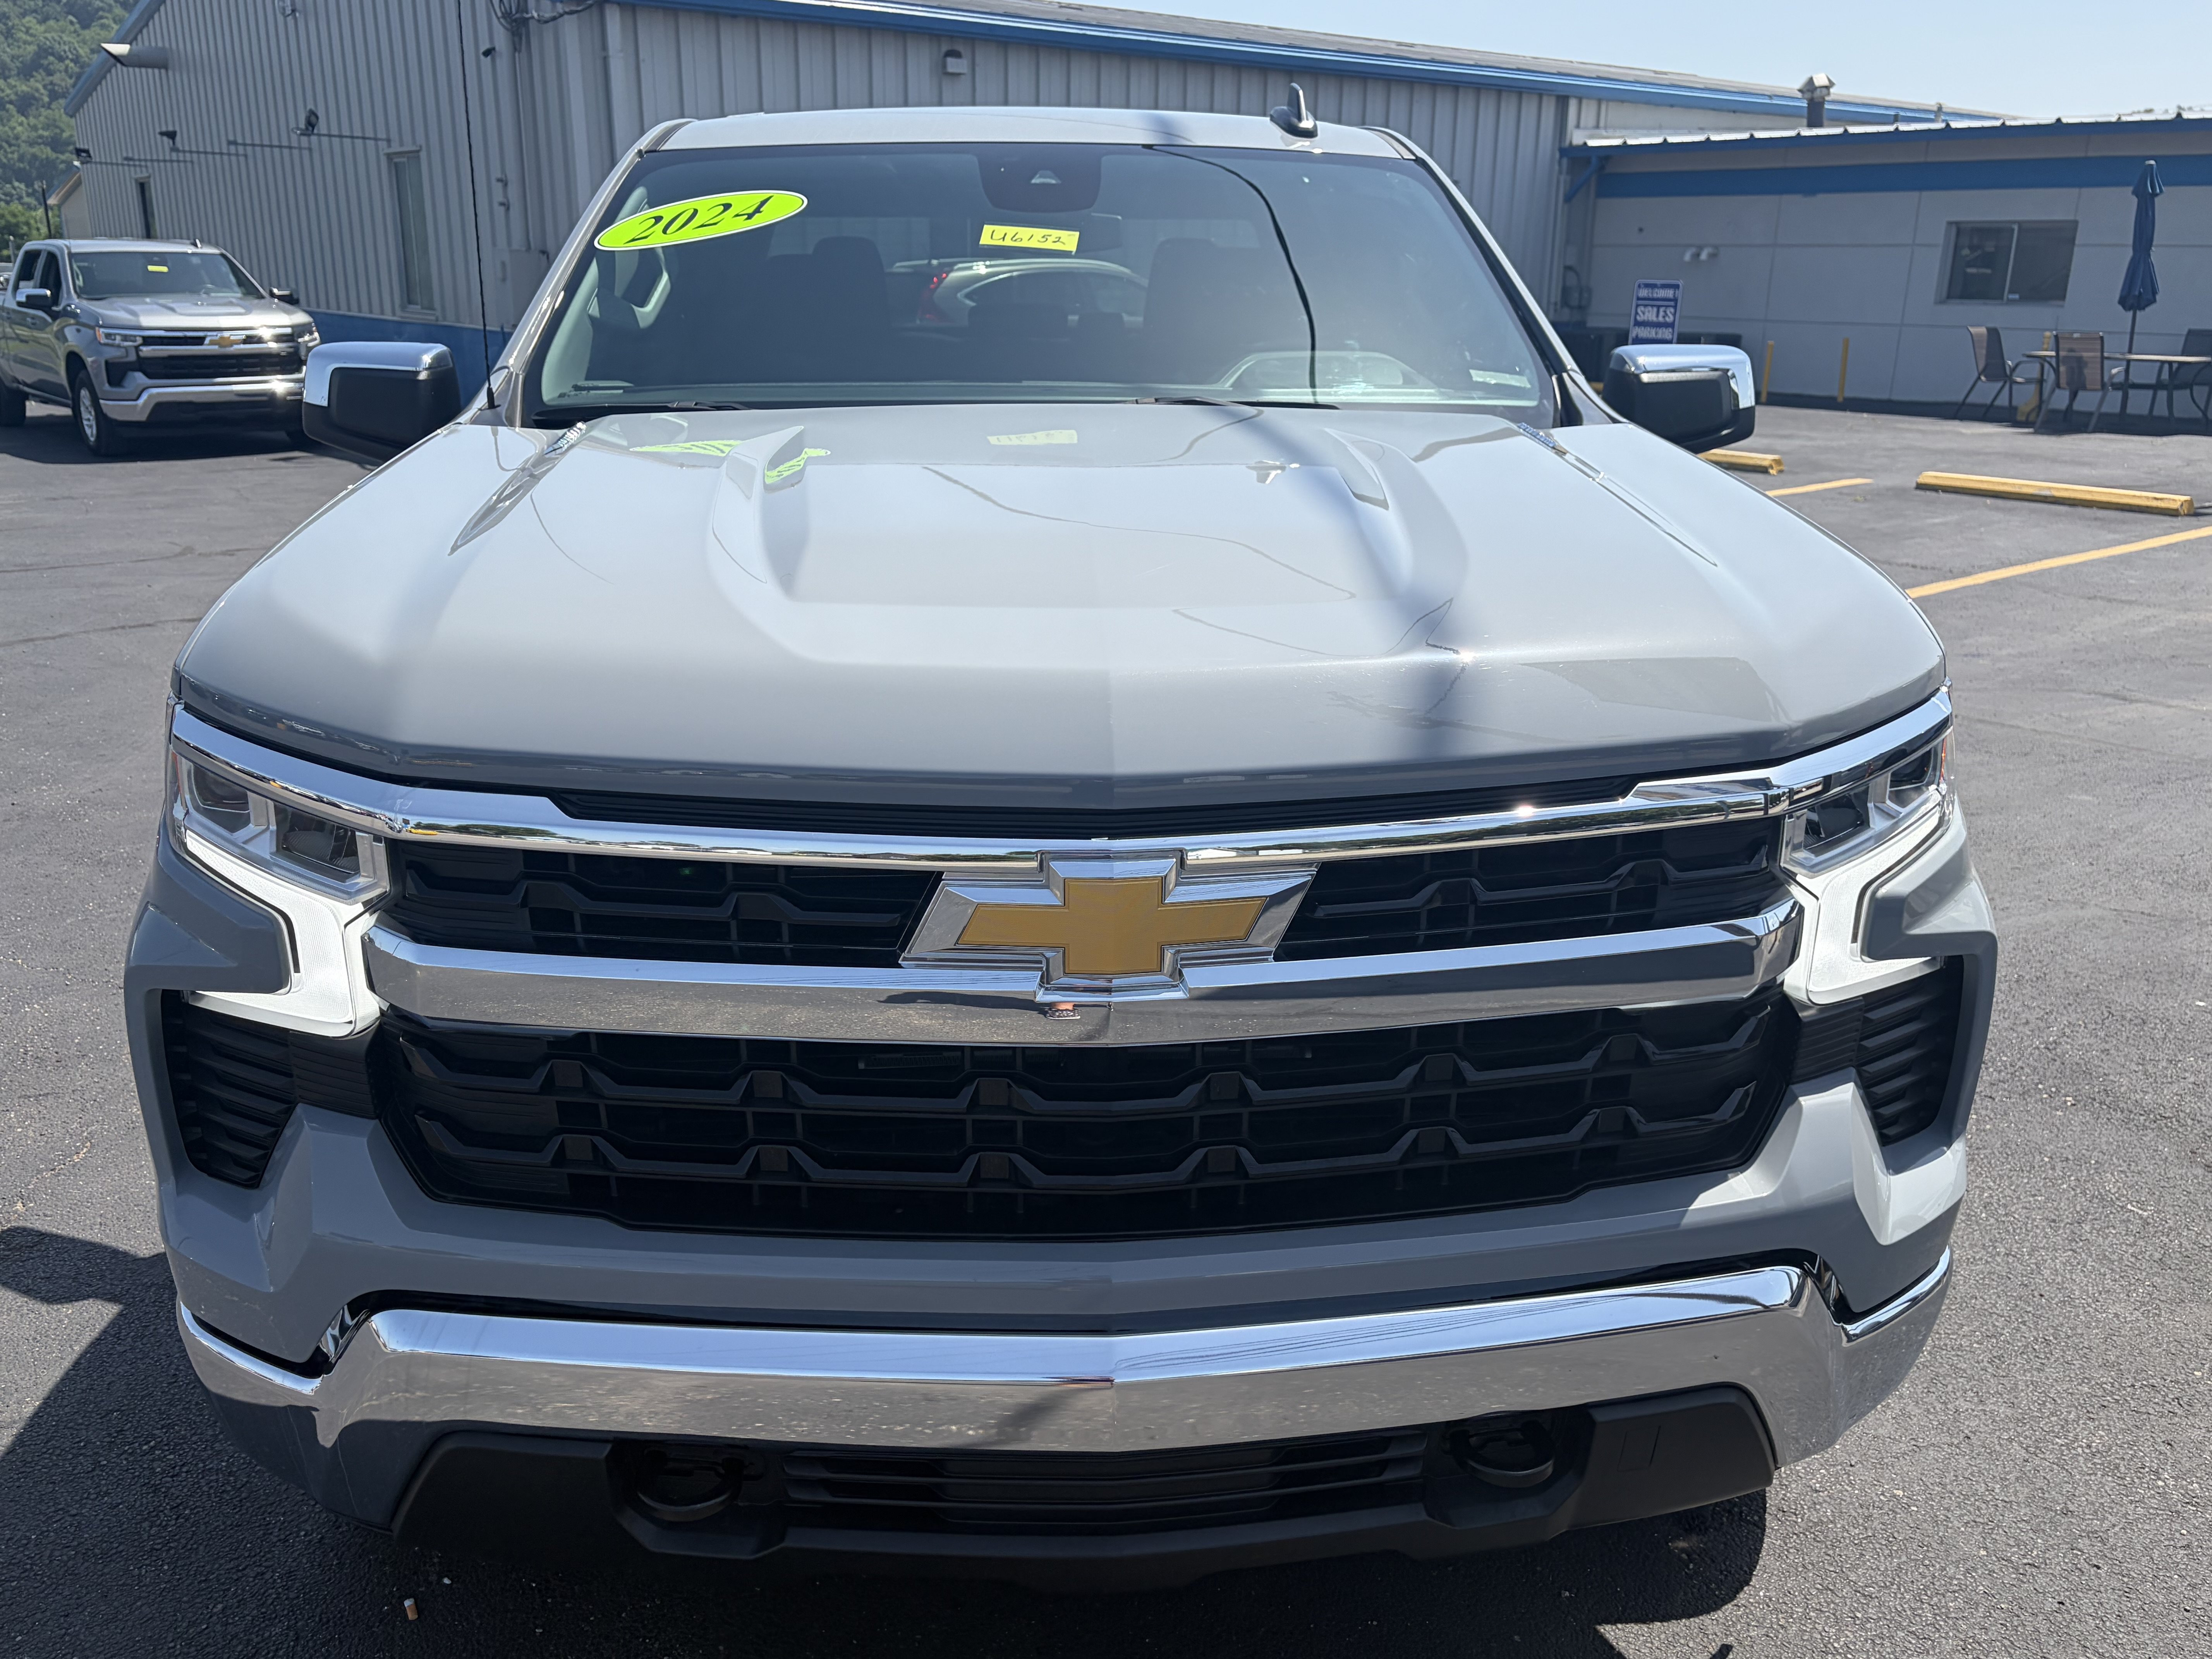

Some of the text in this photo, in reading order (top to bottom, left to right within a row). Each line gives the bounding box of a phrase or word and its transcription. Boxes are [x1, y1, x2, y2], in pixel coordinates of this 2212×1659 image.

[623, 195, 774, 245] 2024
[990, 229, 1066, 246] U6152
[1636, 306, 1675, 323] SALES
